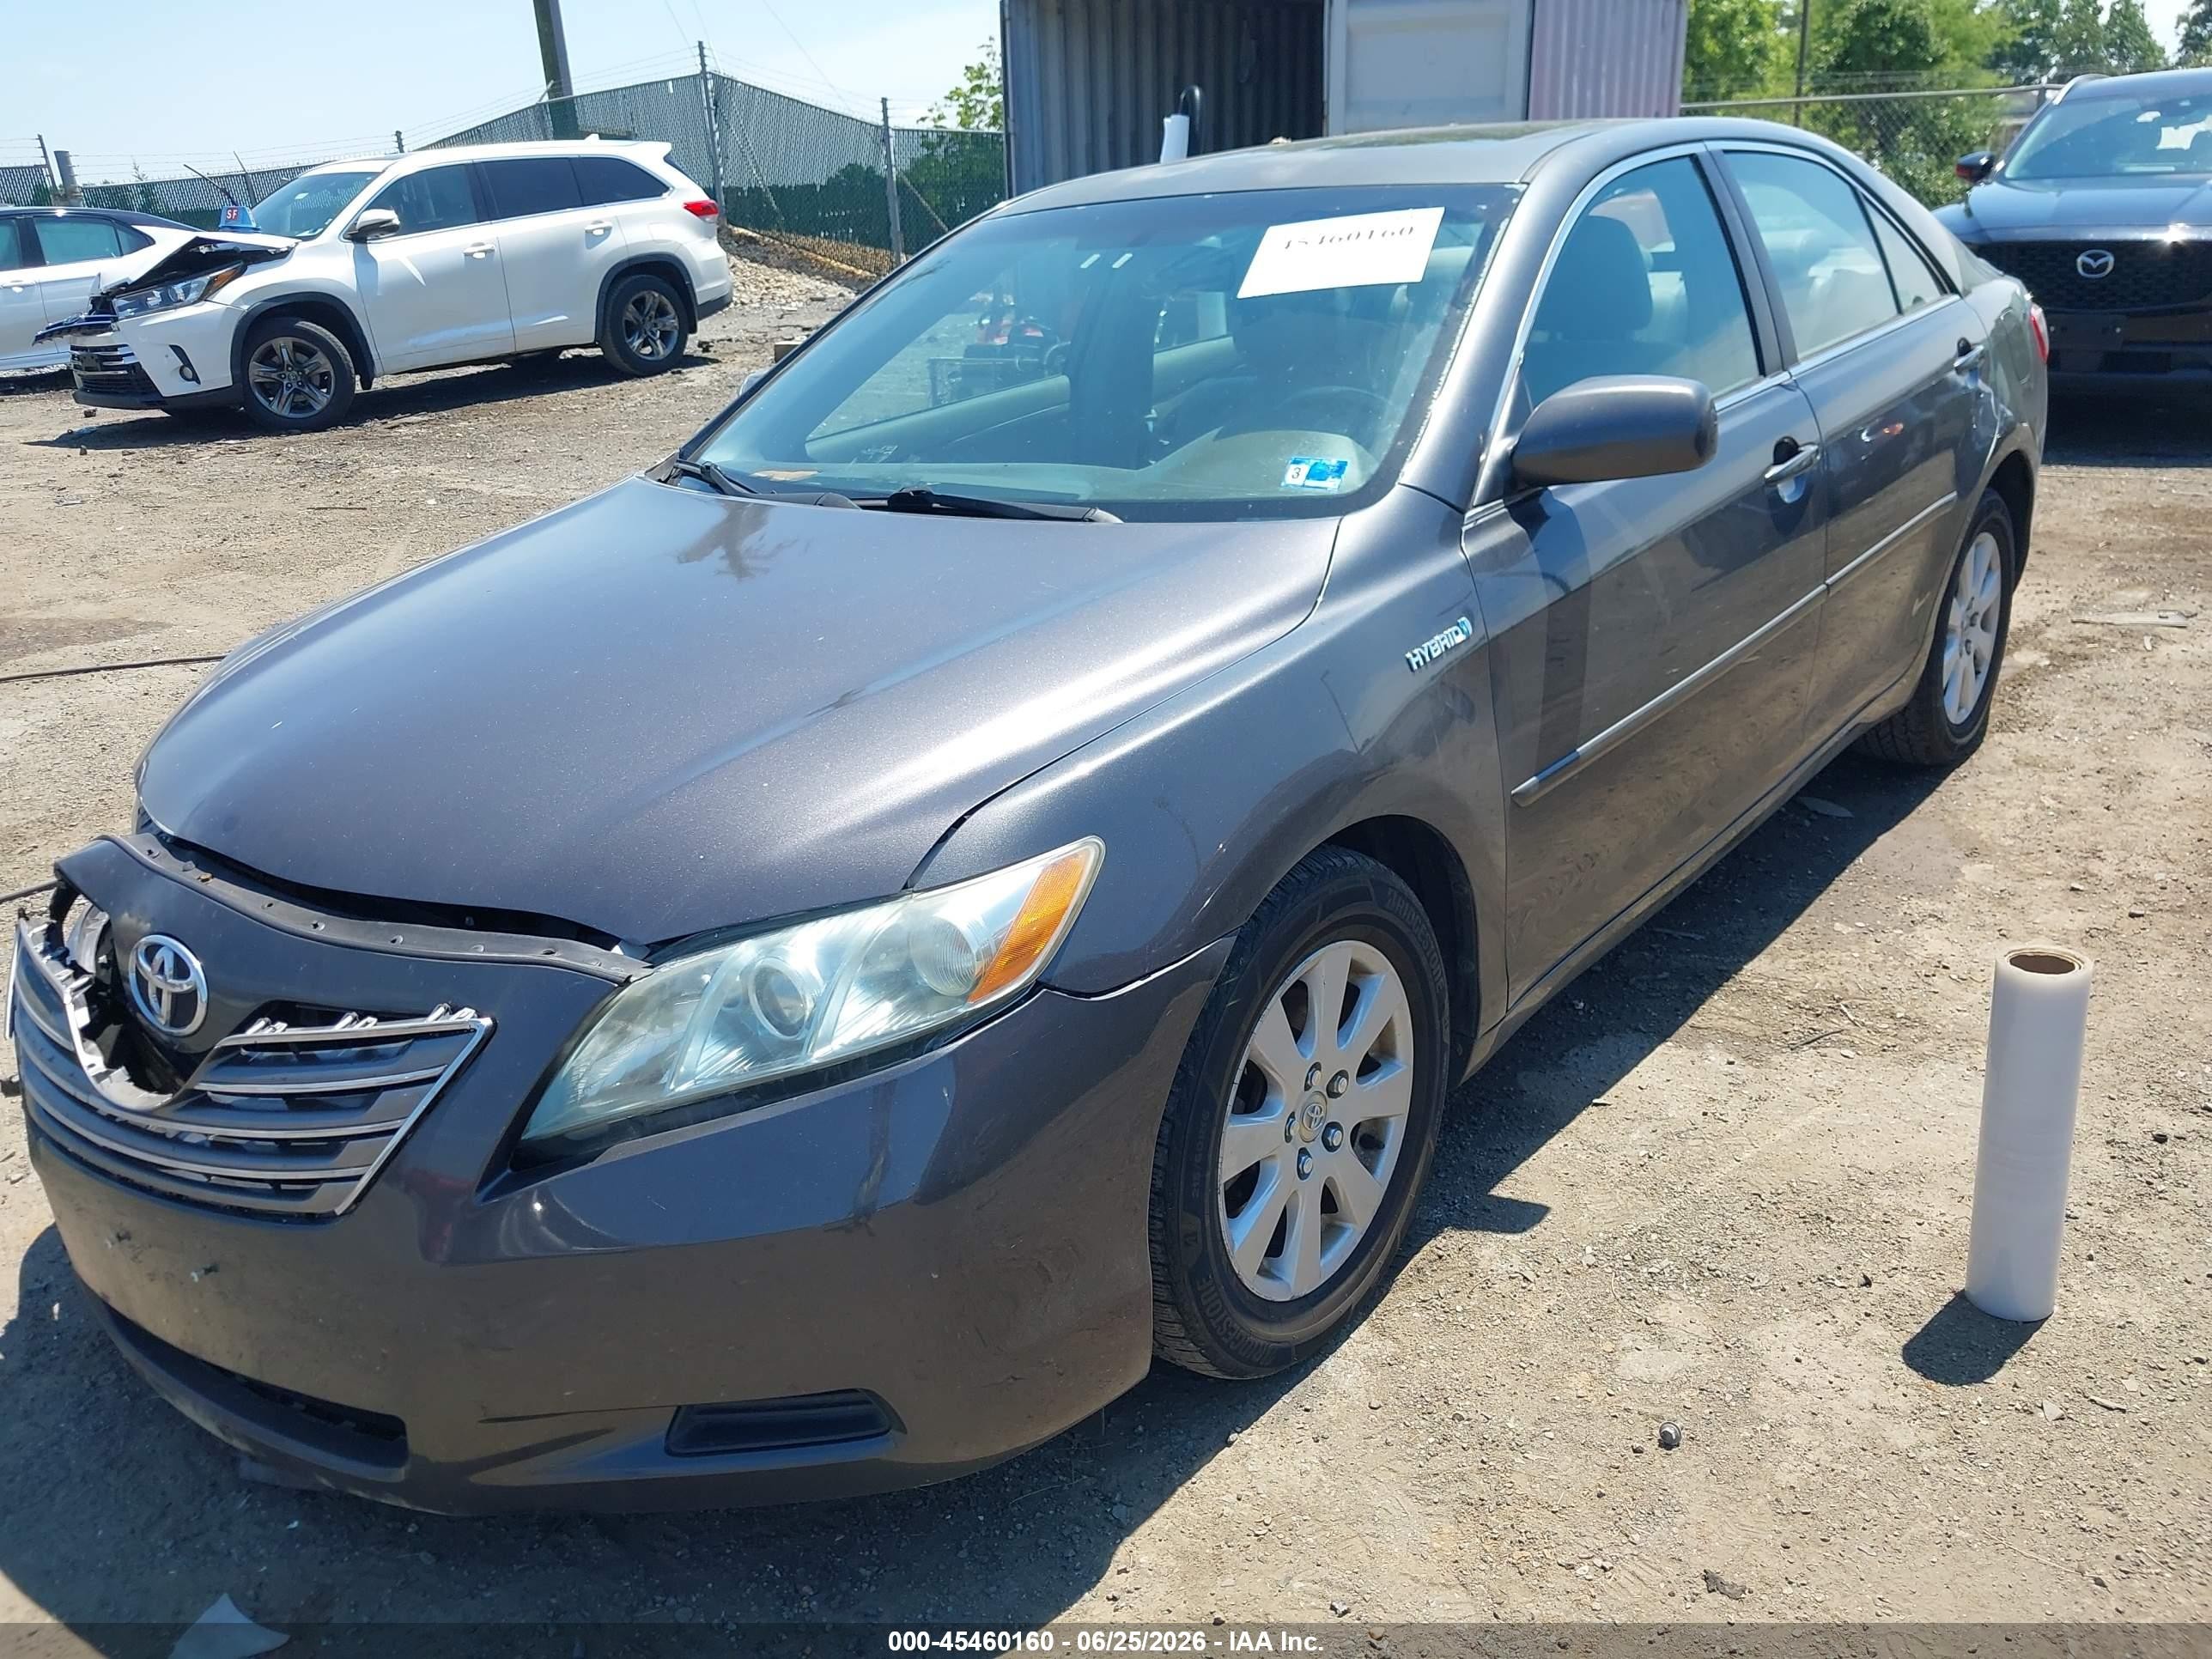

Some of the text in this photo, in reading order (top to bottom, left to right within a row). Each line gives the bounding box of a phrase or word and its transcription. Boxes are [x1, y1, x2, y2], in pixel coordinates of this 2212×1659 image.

[227, 209, 238, 220] SF
[1291, 467, 1302, 479] 3
[1405, 624, 1468, 672] HYBRID
